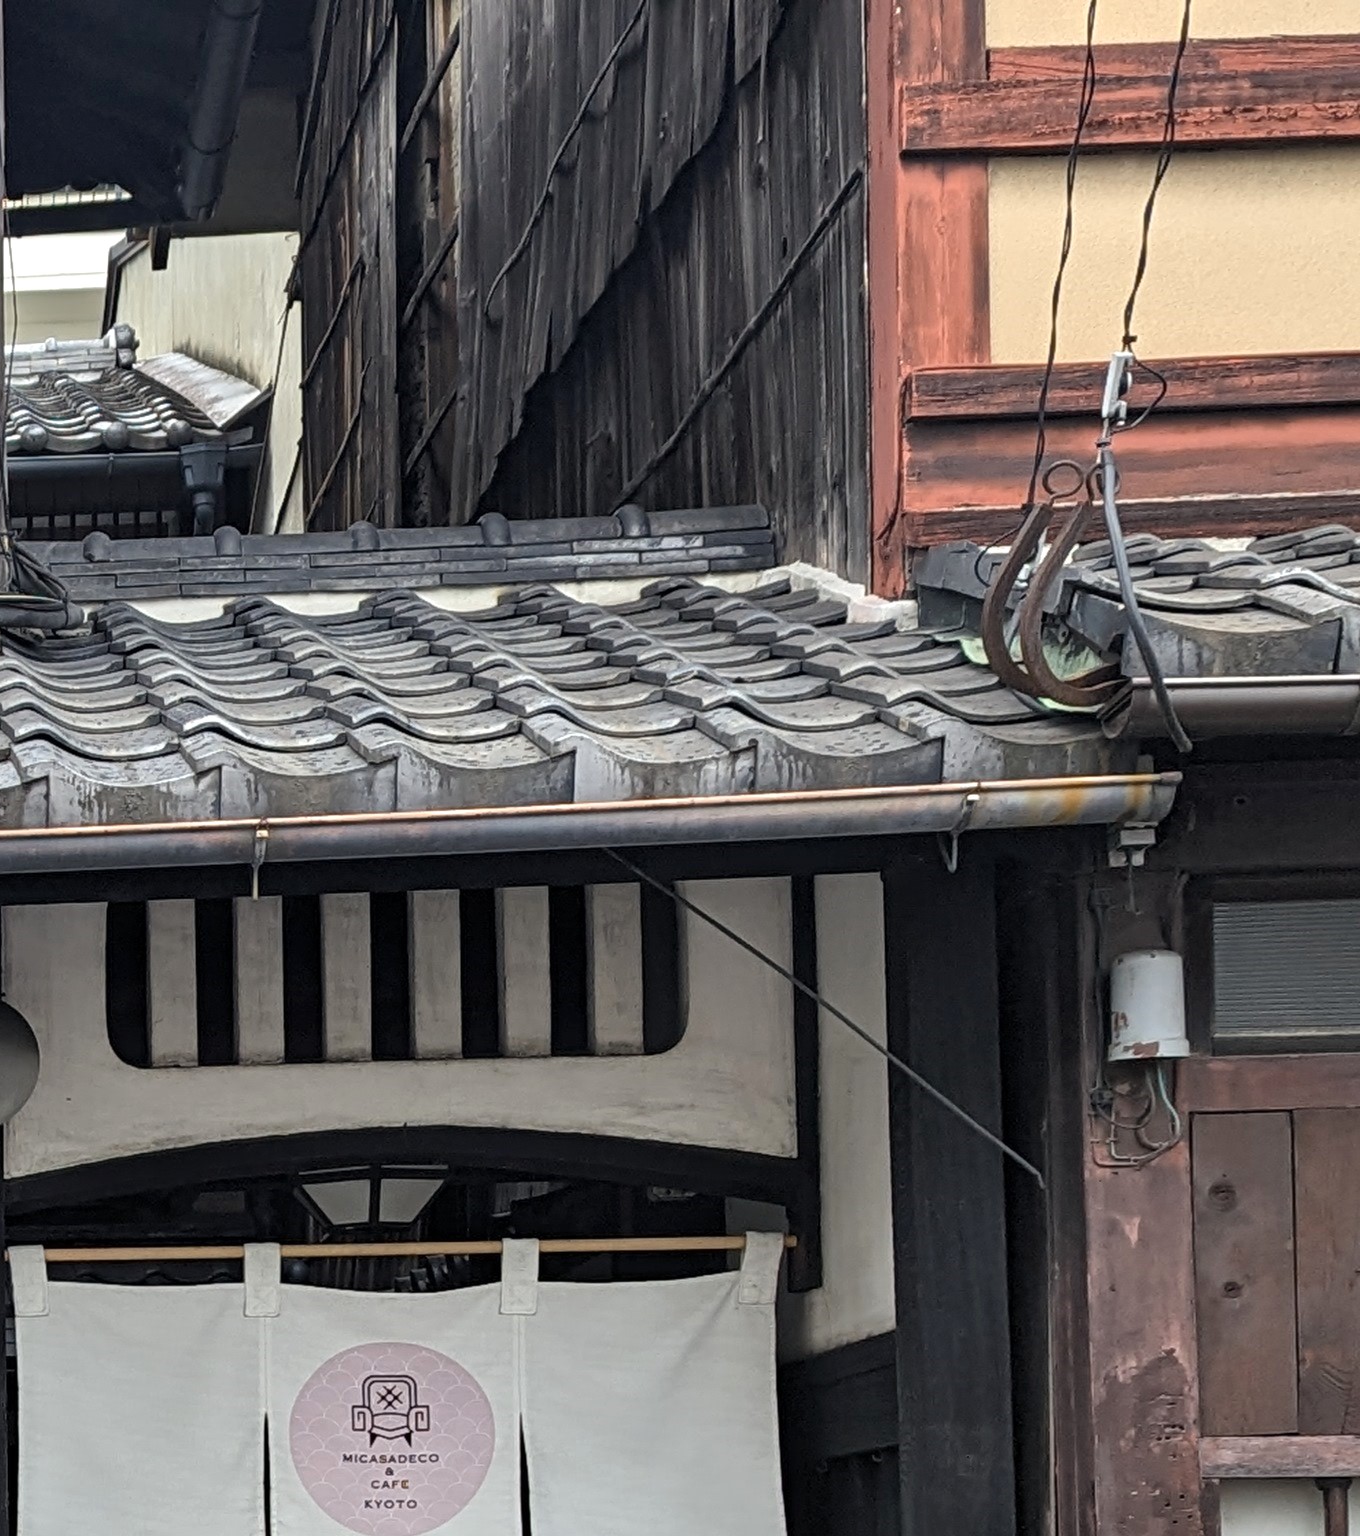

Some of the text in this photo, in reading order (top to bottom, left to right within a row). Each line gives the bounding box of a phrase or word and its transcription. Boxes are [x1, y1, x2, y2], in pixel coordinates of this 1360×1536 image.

[342, 1453, 440, 1465] MICASADECO
[385, 1467, 394, 1477] &
[370, 1479, 410, 1490] CAFE
[364, 1499, 418, 1510] KYOTO
